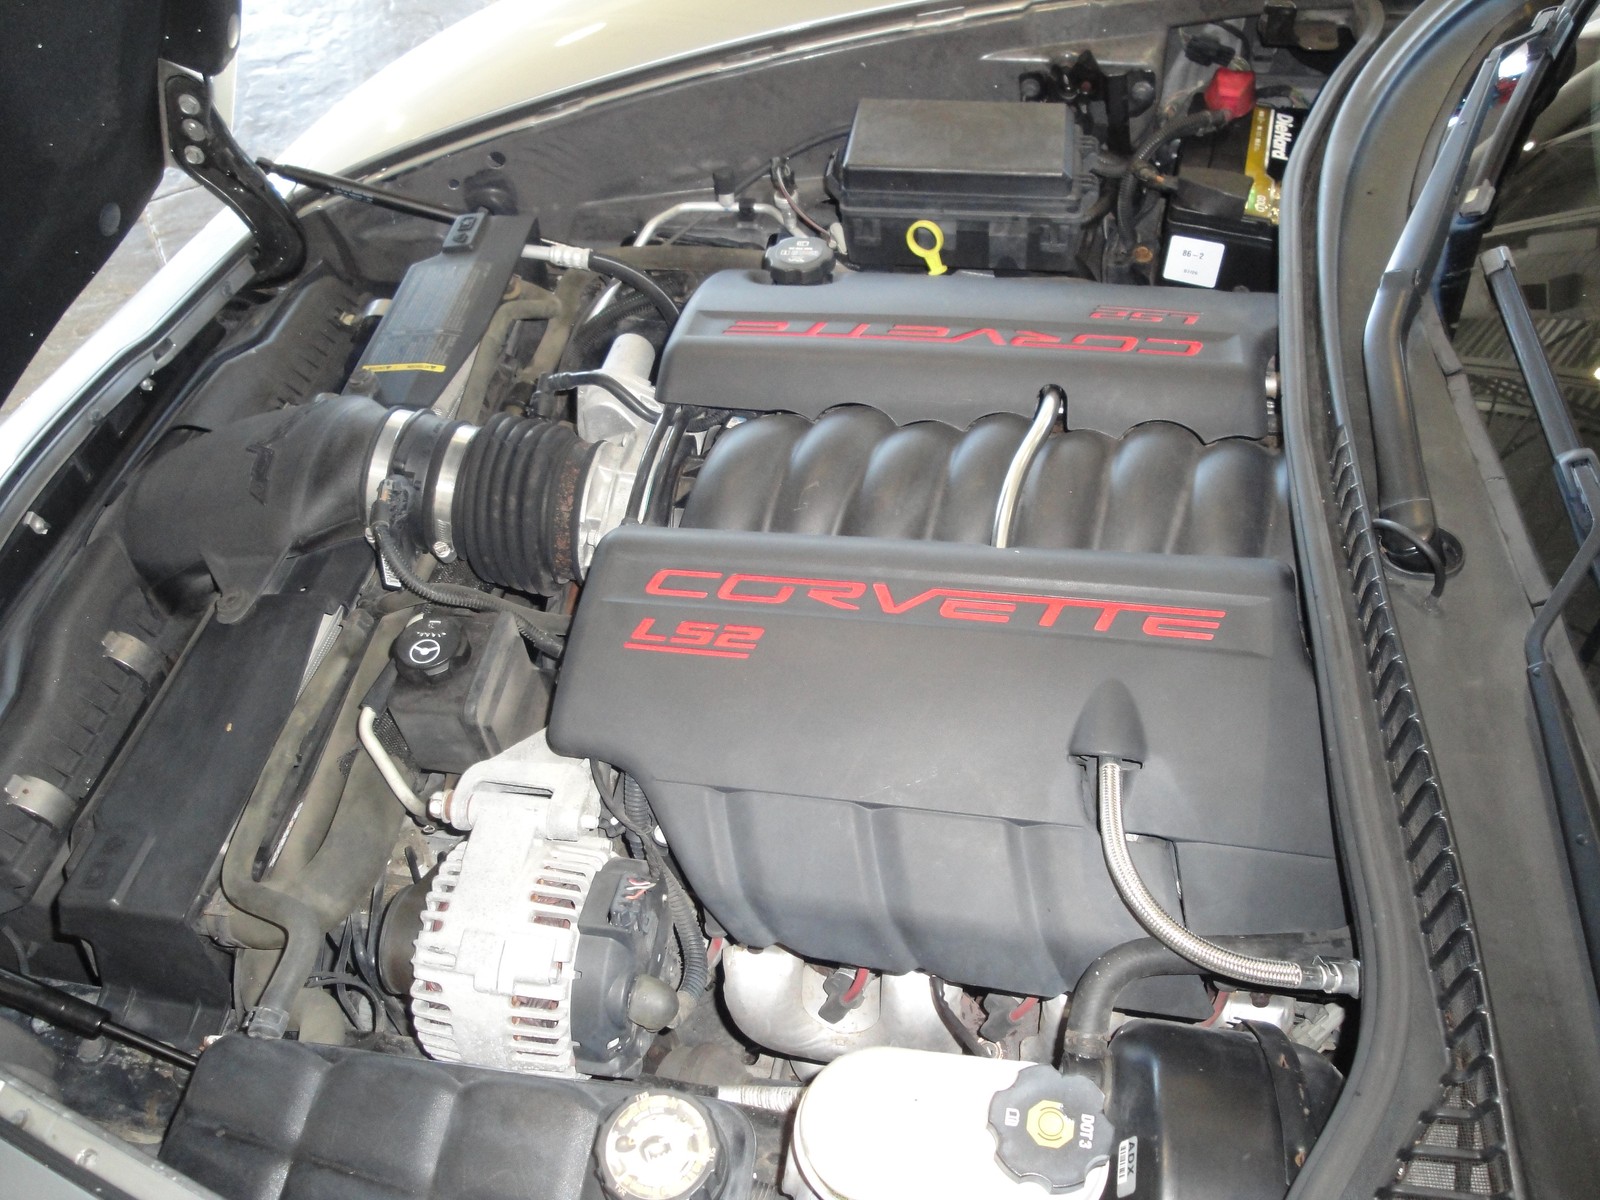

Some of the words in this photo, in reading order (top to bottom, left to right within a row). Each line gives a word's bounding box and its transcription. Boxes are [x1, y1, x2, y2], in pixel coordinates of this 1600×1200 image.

[1271, 112, 1294, 160] DieHard
[1089, 307, 1202, 326] LS2
[722, 320, 1205, 357] CORVETTE
[645, 568, 1228, 641] CORVETTE
[630, 617, 765, 652] LS2
[1079, 1139, 1092, 1149] 3
[1080, 1113, 1095, 1140] DOT
[1127, 1141, 1135, 1177] ADX
